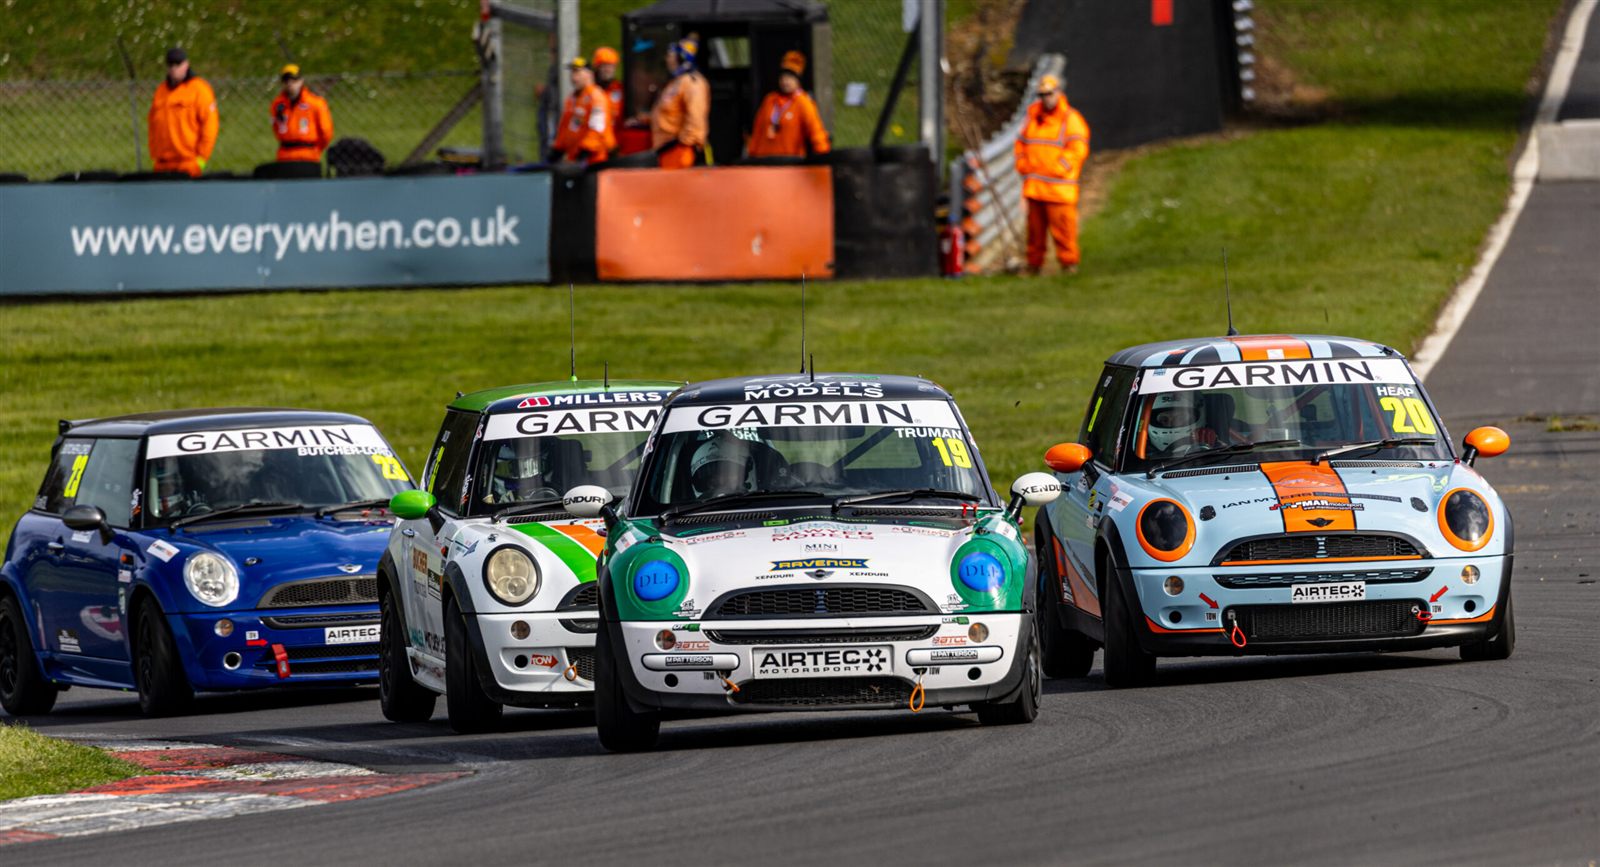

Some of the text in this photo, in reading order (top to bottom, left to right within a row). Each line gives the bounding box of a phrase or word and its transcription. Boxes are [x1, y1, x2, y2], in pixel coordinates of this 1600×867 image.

[71, 206, 519, 260] www.everywhen.co.uk
[1172, 361, 1376, 389] GARMIN
[744, 381, 882, 391] SAWYER
[1376, 386, 1414, 397] HEAP
[553, 392, 662, 405] MILLERS
[744, 387, 884, 401] MODELS
[697, 403, 915, 427] GARMIN
[1379, 397, 1437, 435] 20
[177, 428, 355, 452] GARMIN
[894, 428, 962, 439] TRUMAN
[932, 437, 972, 468] 19
[371, 454, 409, 482] 23
[1222, 500, 1251, 509] IAN
[779, 559, 863, 568] RAVENOL
[1293, 586, 1350, 597] AIRTEC
[328, 628, 377, 639] AIRTEC
[531, 656, 552, 665] TOW
[760, 650, 861, 667] AIRTEC
[760, 666, 860, 674] MOTORSPORT
